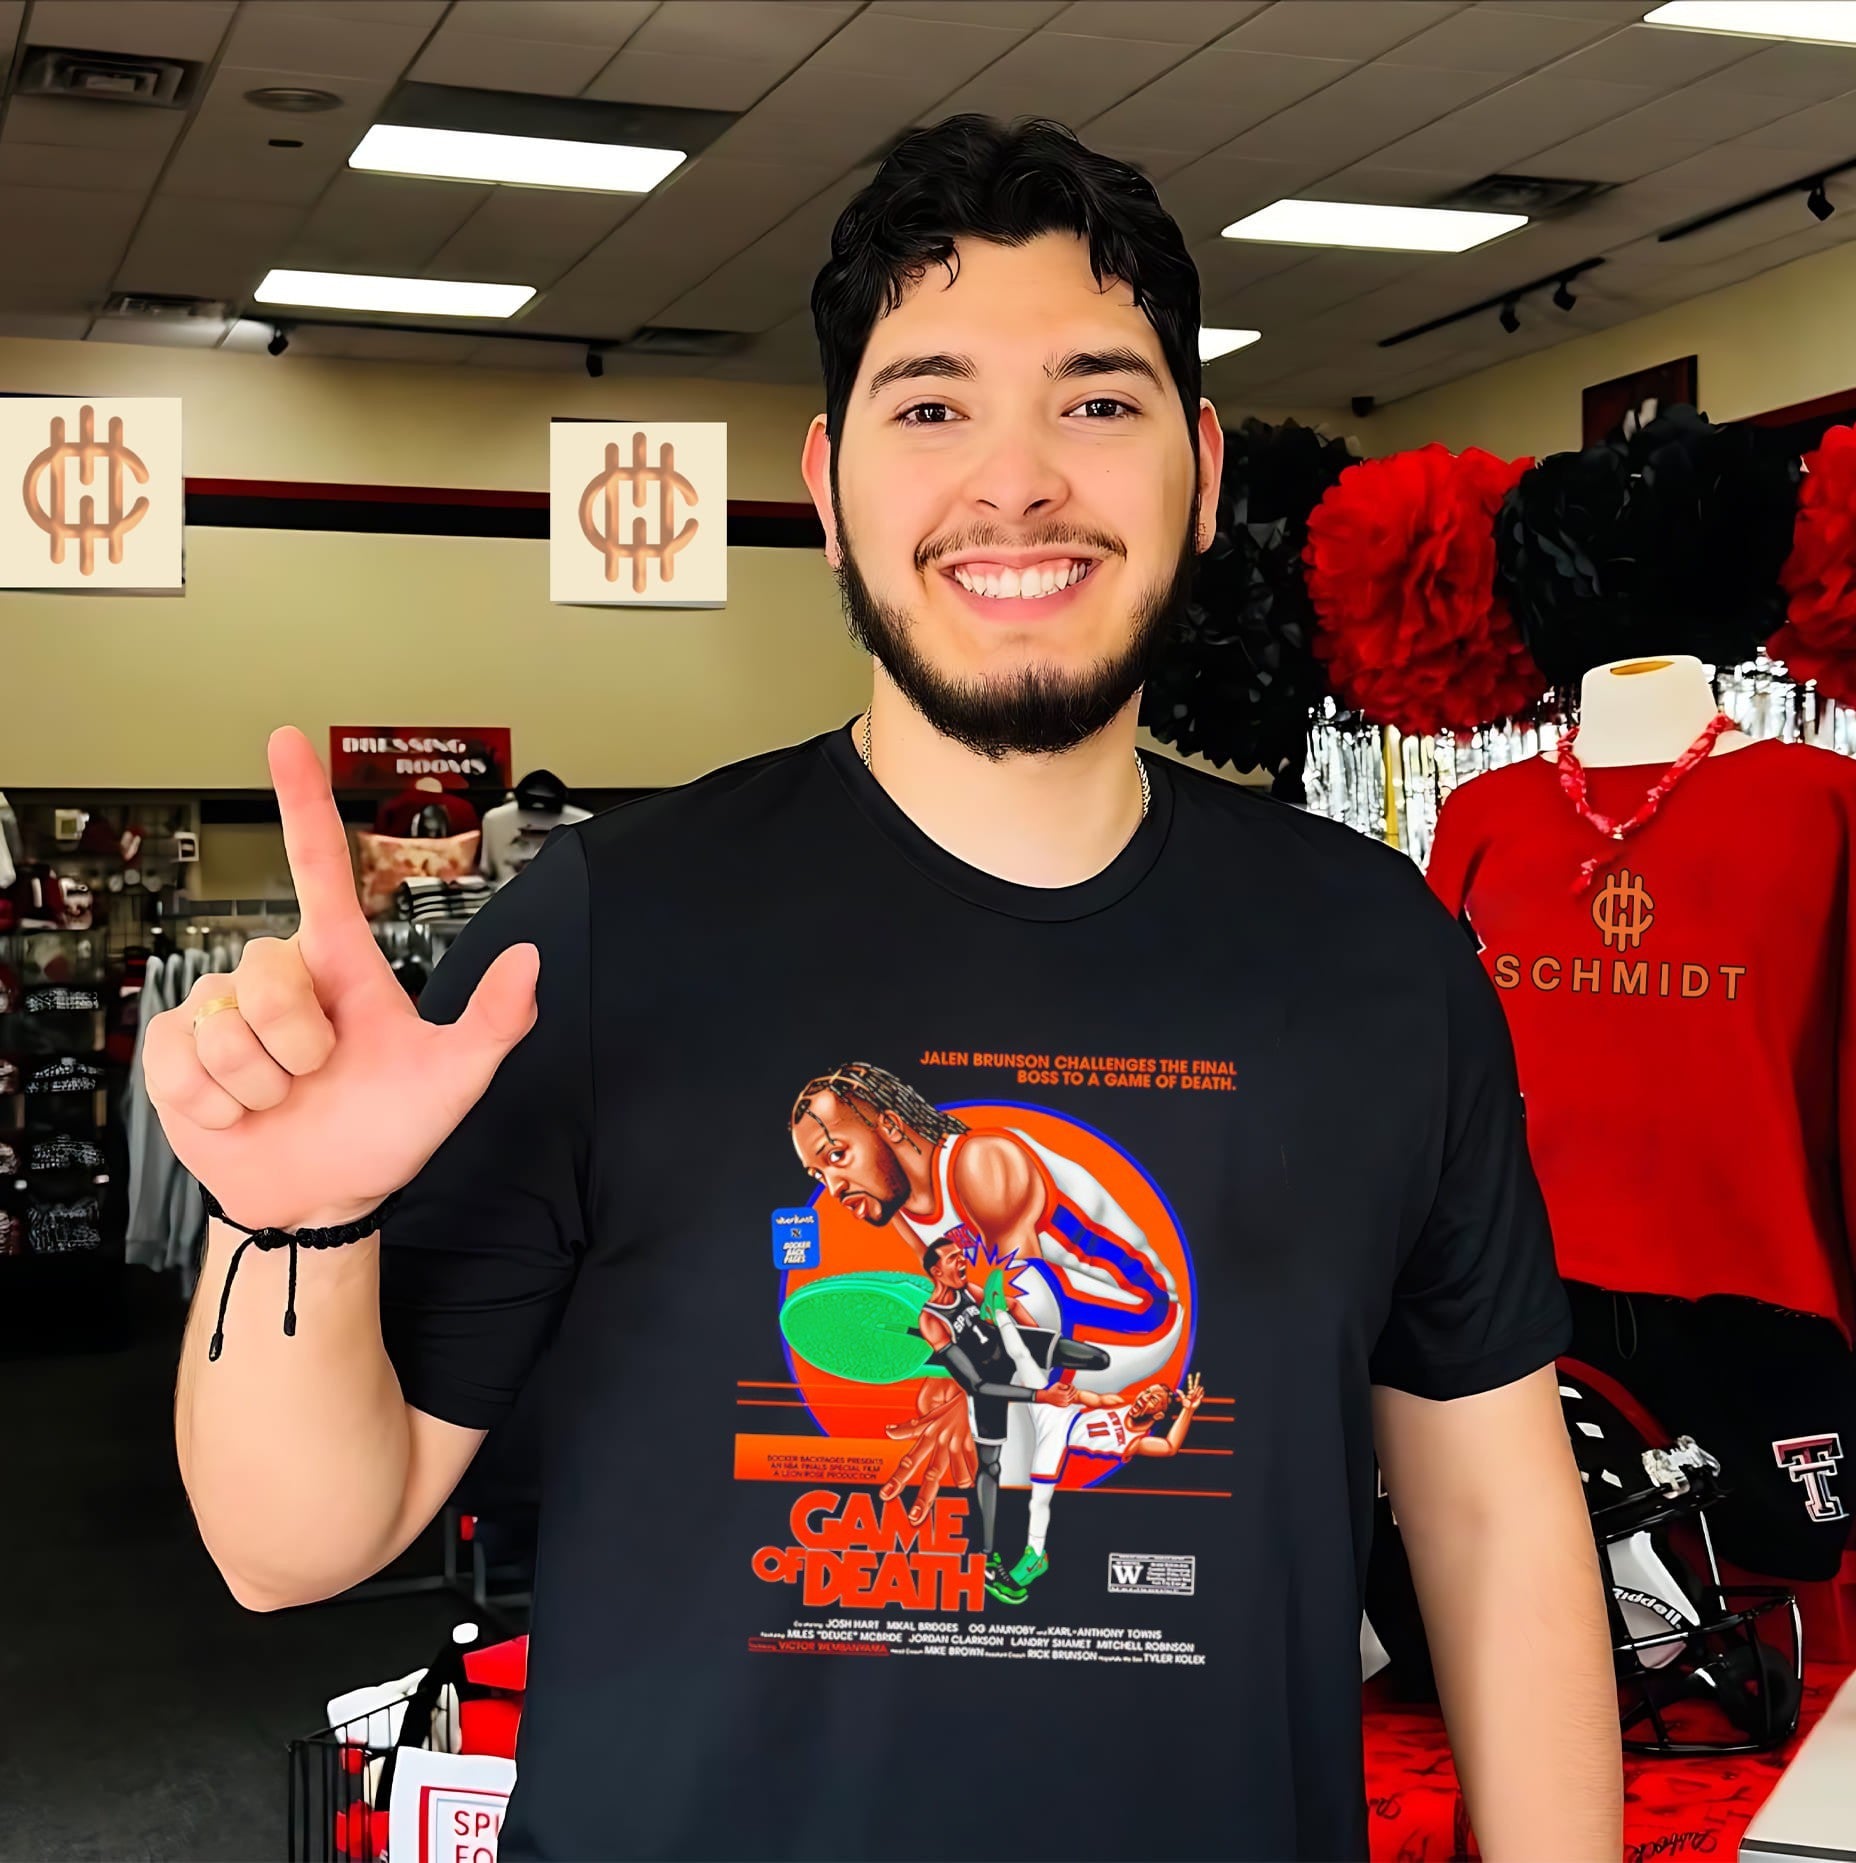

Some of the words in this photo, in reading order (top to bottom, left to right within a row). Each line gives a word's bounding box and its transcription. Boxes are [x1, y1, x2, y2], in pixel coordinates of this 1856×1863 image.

[342, 737, 466, 754] DRESSING
[396, 758, 487, 775] ROOMS
[1494, 953, 1747, 1000] SCHMIDT
[919, 1050, 968, 1067] JALEN
[972, 1053, 1050, 1069] BRUNSON
[1054, 1055, 1157, 1073] CHALLENGES
[1159, 1059, 1188, 1074] THE
[1192, 1060, 1237, 1075] FINAL
[1017, 1069, 1059, 1085] BOSS
[1063, 1071, 1085, 1086] TO
[1087, 1072, 1100, 1087] A
[1104, 1073, 1151, 1088] GAME
[1155, 1074, 1178, 1089] OF
[1181, 1076, 1237, 1091] DEATH.
[972, 1325, 989, 1344] 1
[1086, 1421, 1111, 1438] 11
[790, 1489, 970, 1555] GAME
[752, 1545, 805, 1584] OF
[803, 1549, 987, 1612] DEATH
[1112, 1564, 1144, 1584] W
[825, 1618, 852, 1629] JOSH
[853, 1620, 879, 1630] HART
[886, 1620, 916, 1631] MIKAL
[918, 1622, 959, 1632] BRIDGES
[968, 1623, 986, 1634] OG
[988, 1624, 1036, 1635] ANUNOBY
[1047, 1626, 1125, 1638] KARL-ANTHONY
[1127, 1628, 1162, 1640] TOWNS
[787, 1629, 815, 1639] MILES
[908, 1633, 949, 1644] JORDAN
[951, 1634, 1004, 1646] CLARKSON
[1010, 1636, 1050, 1647] LANDRY
[1052, 1638, 1091, 1648] SHAMET
[1096, 1640, 1143, 1651] MITCHELL
[1144, 1641, 1195, 1652] ROBINSON
[778, 1640, 815, 1650] VICTOR
[924, 1646, 946, 1656] MIKE
[948, 1646, 984, 1656] BROWN
[1027, 1649, 1050, 1659] RICK
[1052, 1650, 1098, 1660] BRUNSON
[1143, 1652, 1174, 1664] TYLER
